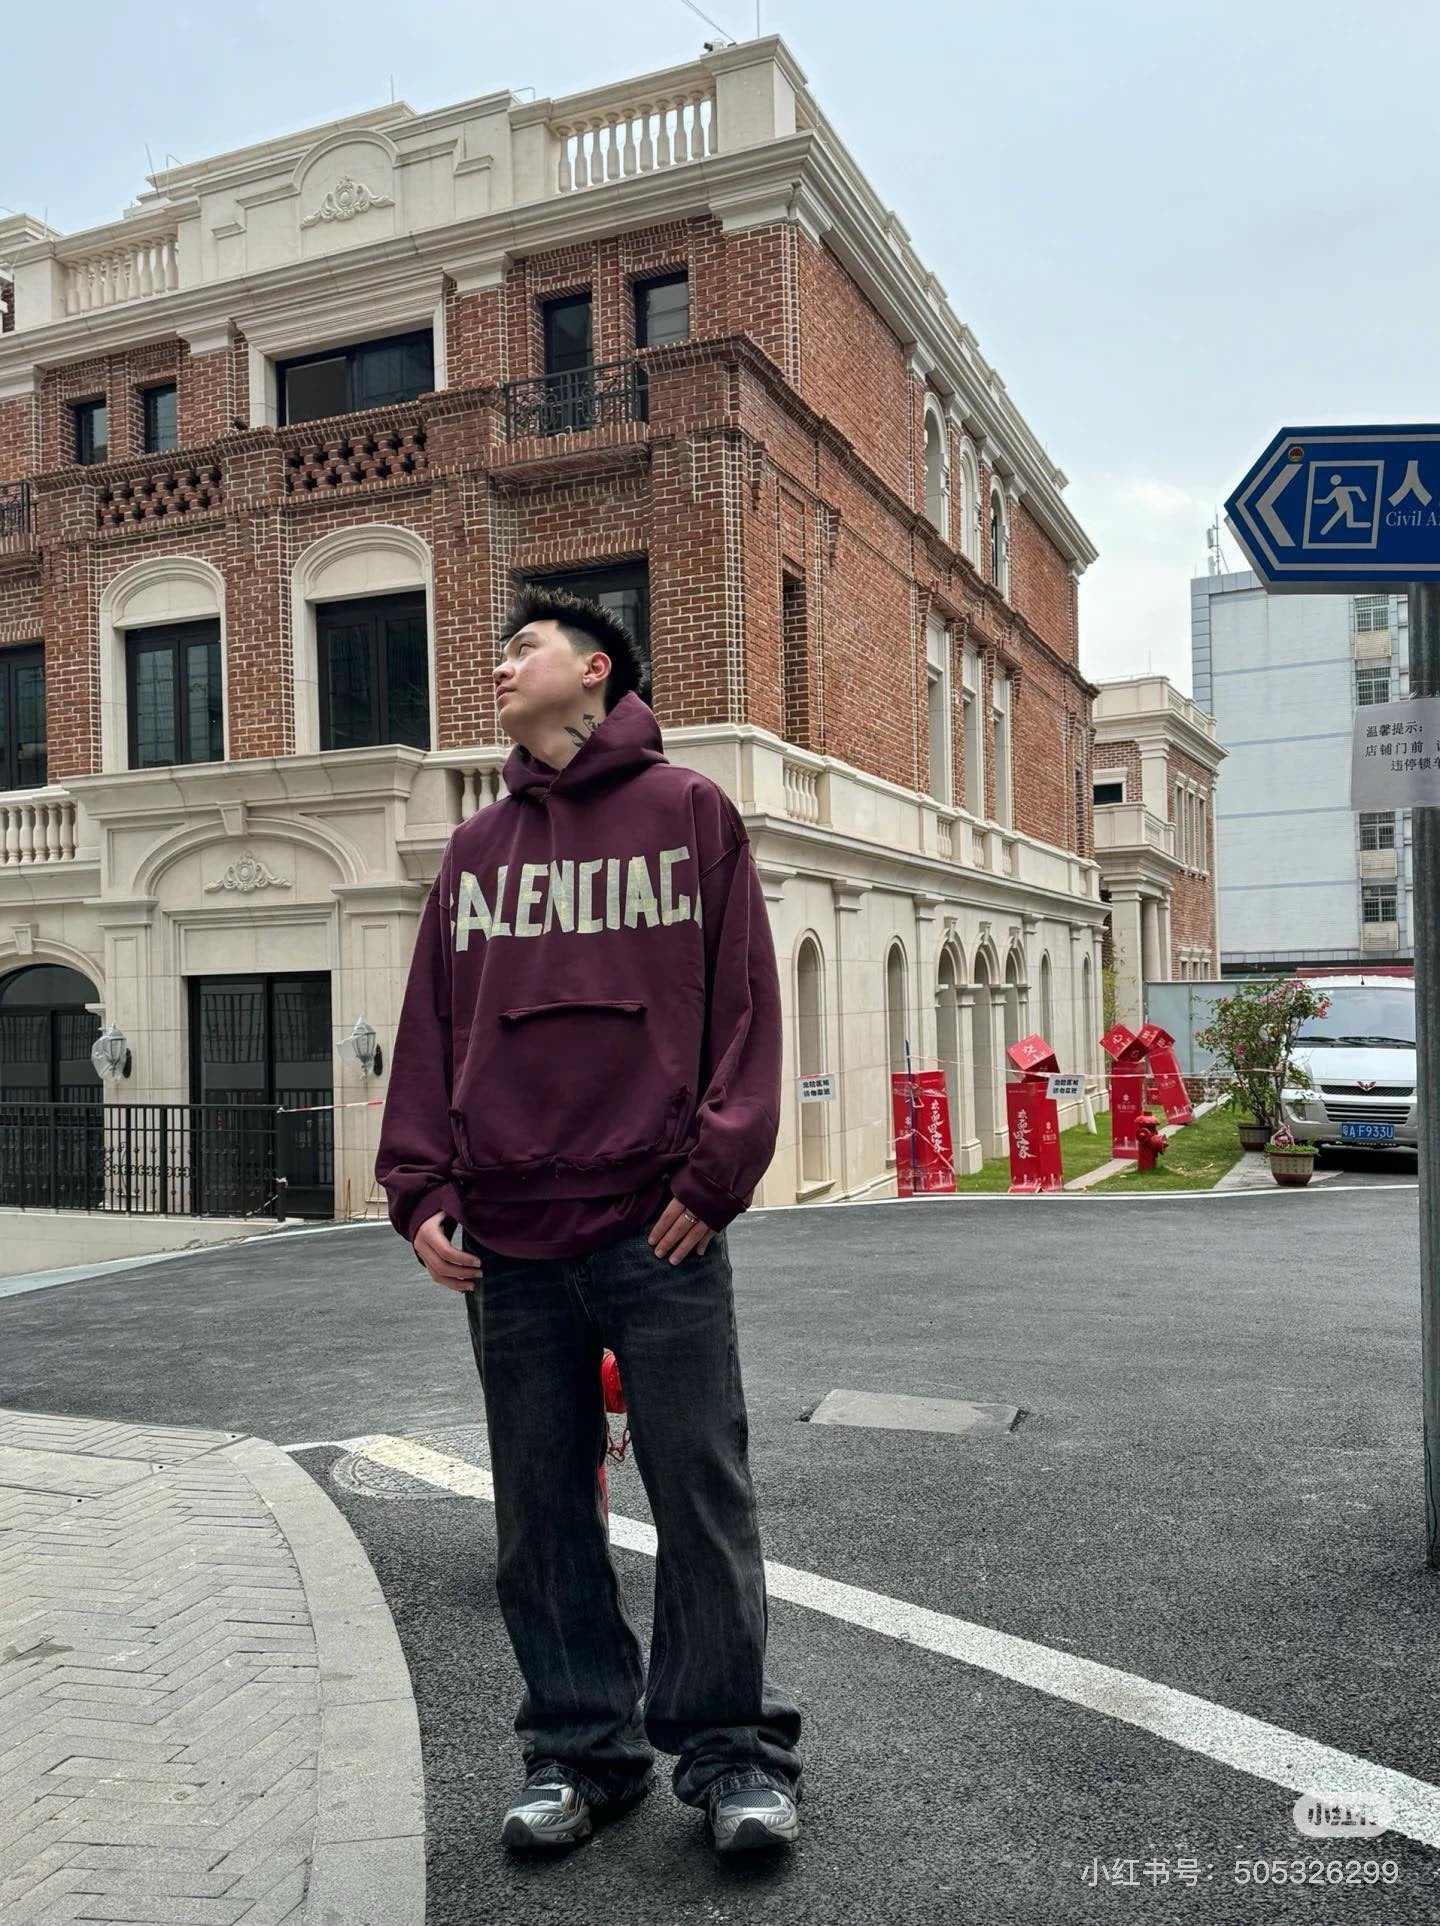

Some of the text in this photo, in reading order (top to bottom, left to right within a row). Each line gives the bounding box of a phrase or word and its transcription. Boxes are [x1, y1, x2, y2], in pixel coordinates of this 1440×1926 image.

[1386, 510, 1422, 527] Civil
[1365, 741, 1424, 758] 店铺门前
